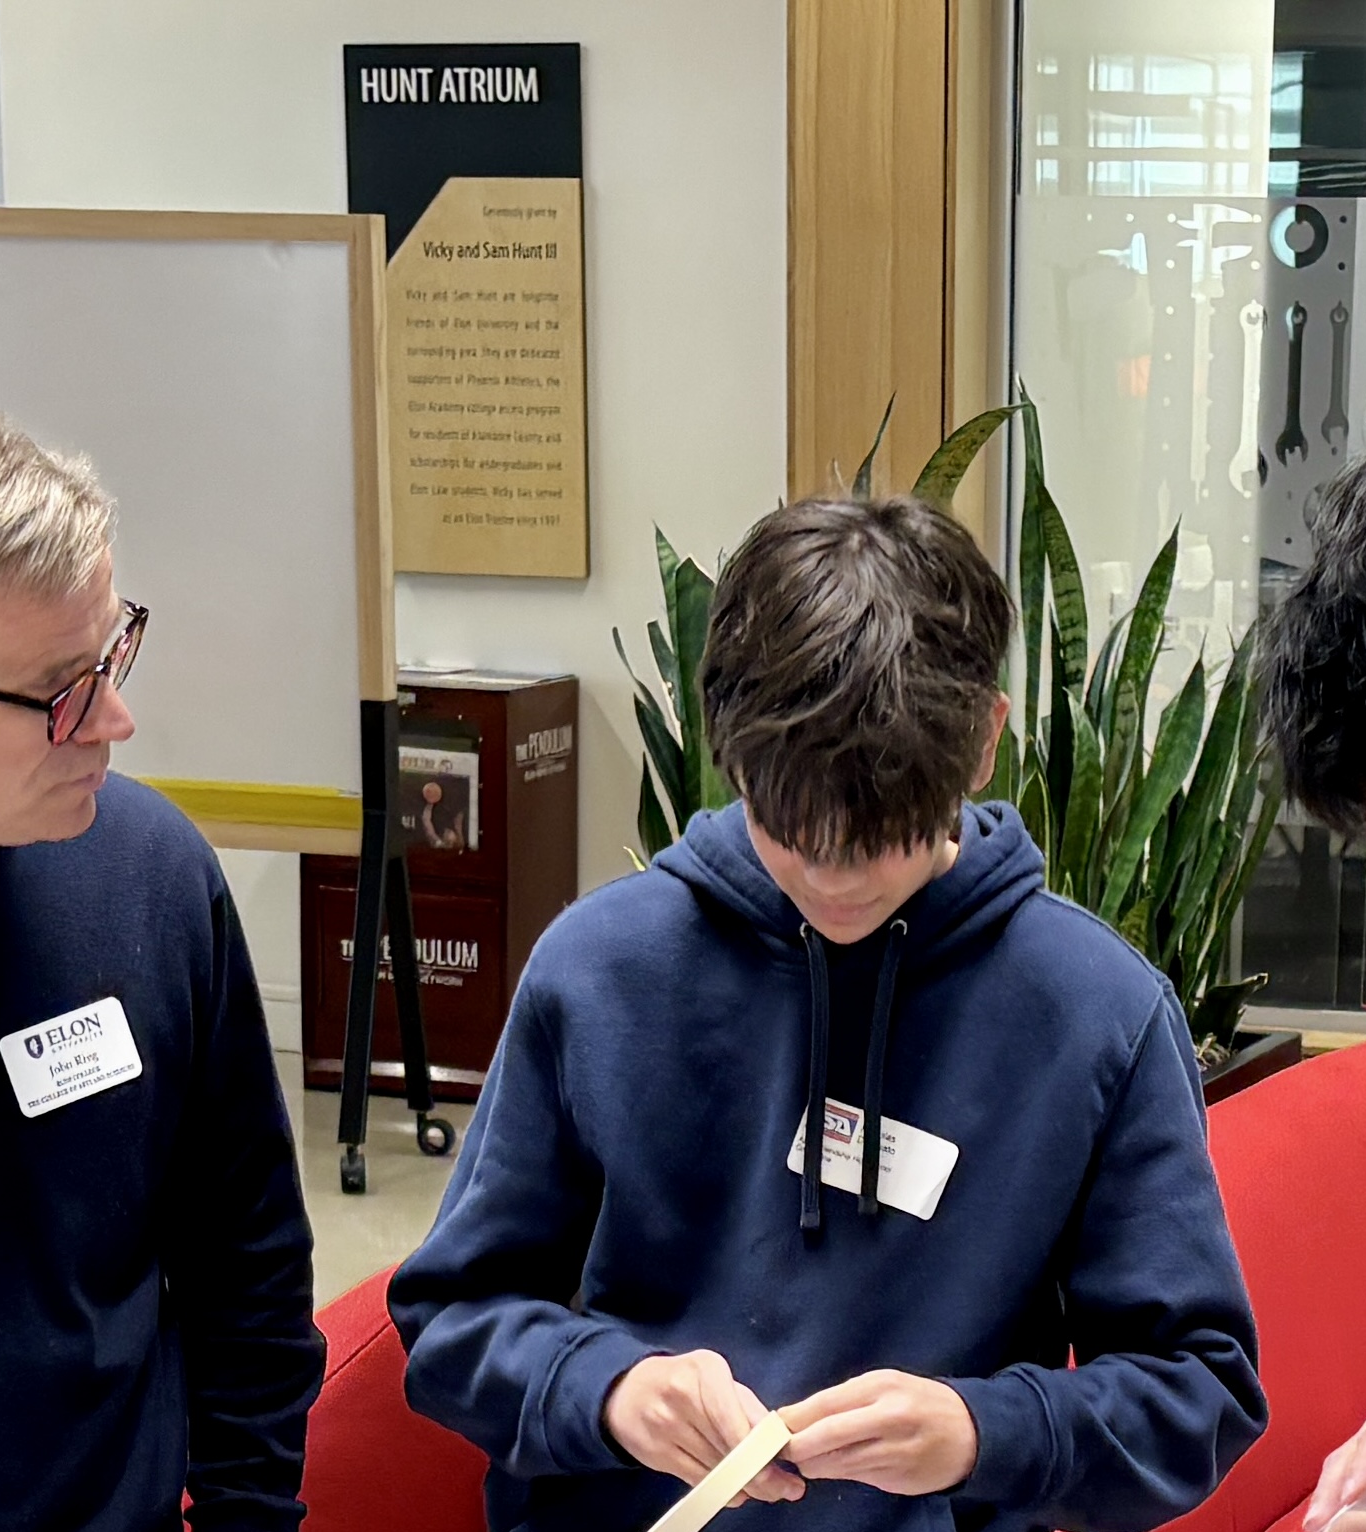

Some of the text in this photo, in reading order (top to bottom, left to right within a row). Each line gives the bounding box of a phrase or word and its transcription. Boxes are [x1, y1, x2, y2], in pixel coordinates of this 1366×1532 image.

[360, 67, 539, 103] HUNT ATRIUM
[423, 241, 454, 262] Vicky
[457, 241, 480, 259] and
[483, 241, 509, 259] Sam
[512, 242, 542, 259] Hunt
[45, 1013, 101, 1046] ELON
[48, 1061, 73, 1079] John
